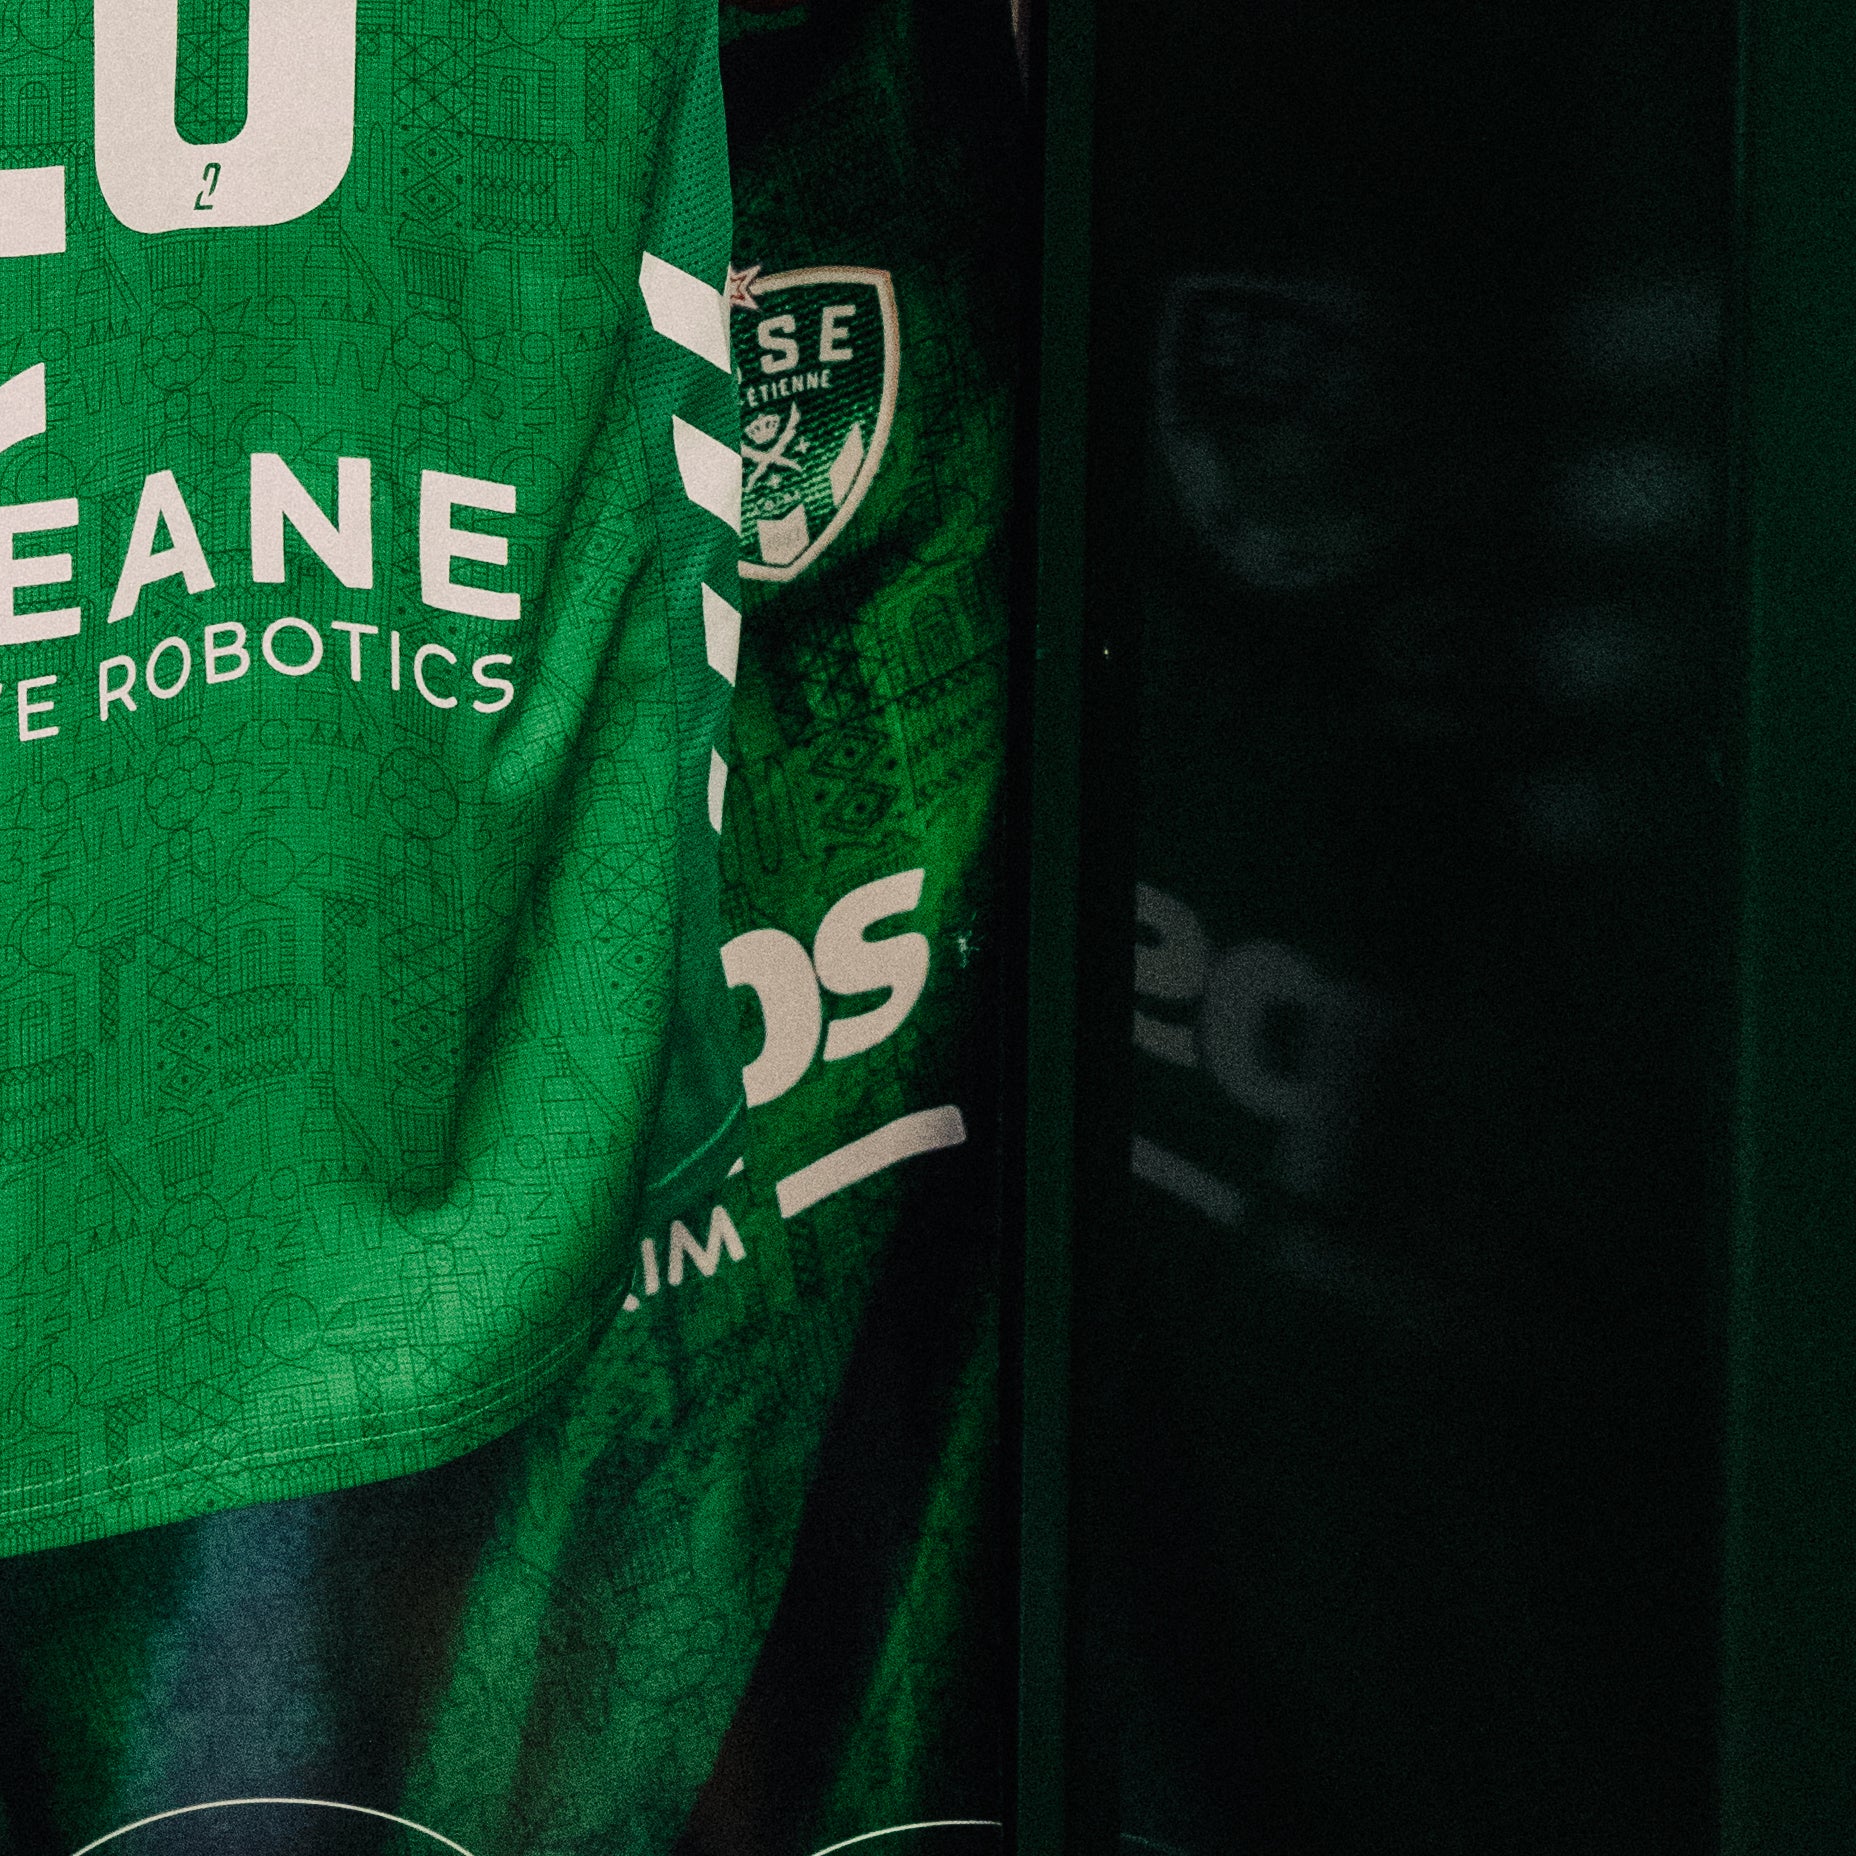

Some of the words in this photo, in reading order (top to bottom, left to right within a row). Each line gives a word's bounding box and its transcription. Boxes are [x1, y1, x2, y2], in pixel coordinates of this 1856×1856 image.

[737, 304, 857, 375] SE
[97, 615, 517, 724] ROBOTICS
[622, 1205, 746, 1312] IM
